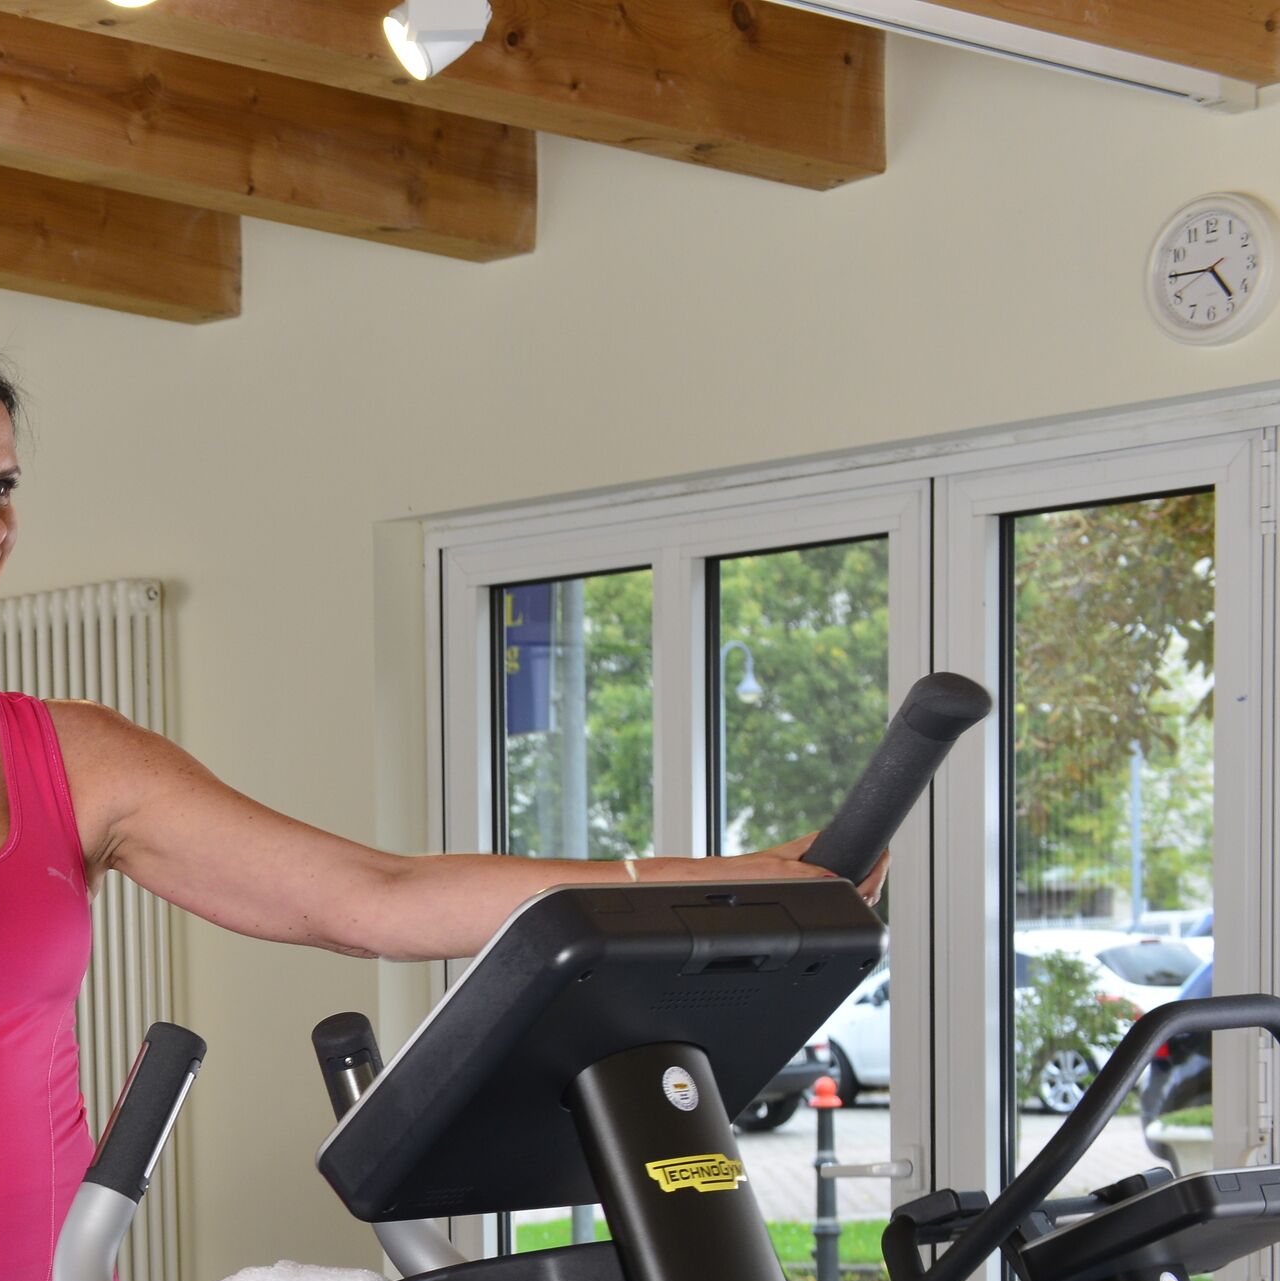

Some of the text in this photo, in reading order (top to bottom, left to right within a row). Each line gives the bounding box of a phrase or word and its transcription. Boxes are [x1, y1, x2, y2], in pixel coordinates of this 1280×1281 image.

[1206, 218, 1218, 234] 12
[1187, 227, 1197, 243] 11
[1241, 232, 1249, 248] 2
[1173, 248, 1186, 263] 10
[1246, 255, 1256, 270] 3
[1169, 270, 1178, 284] 9
[1240, 278, 1248, 293] 4
[1174, 291, 1183, 305] 8
[1226, 296, 1235, 313] 5
[1189, 303, 1197, 320] 7
[1206, 305, 1216, 321] 6
